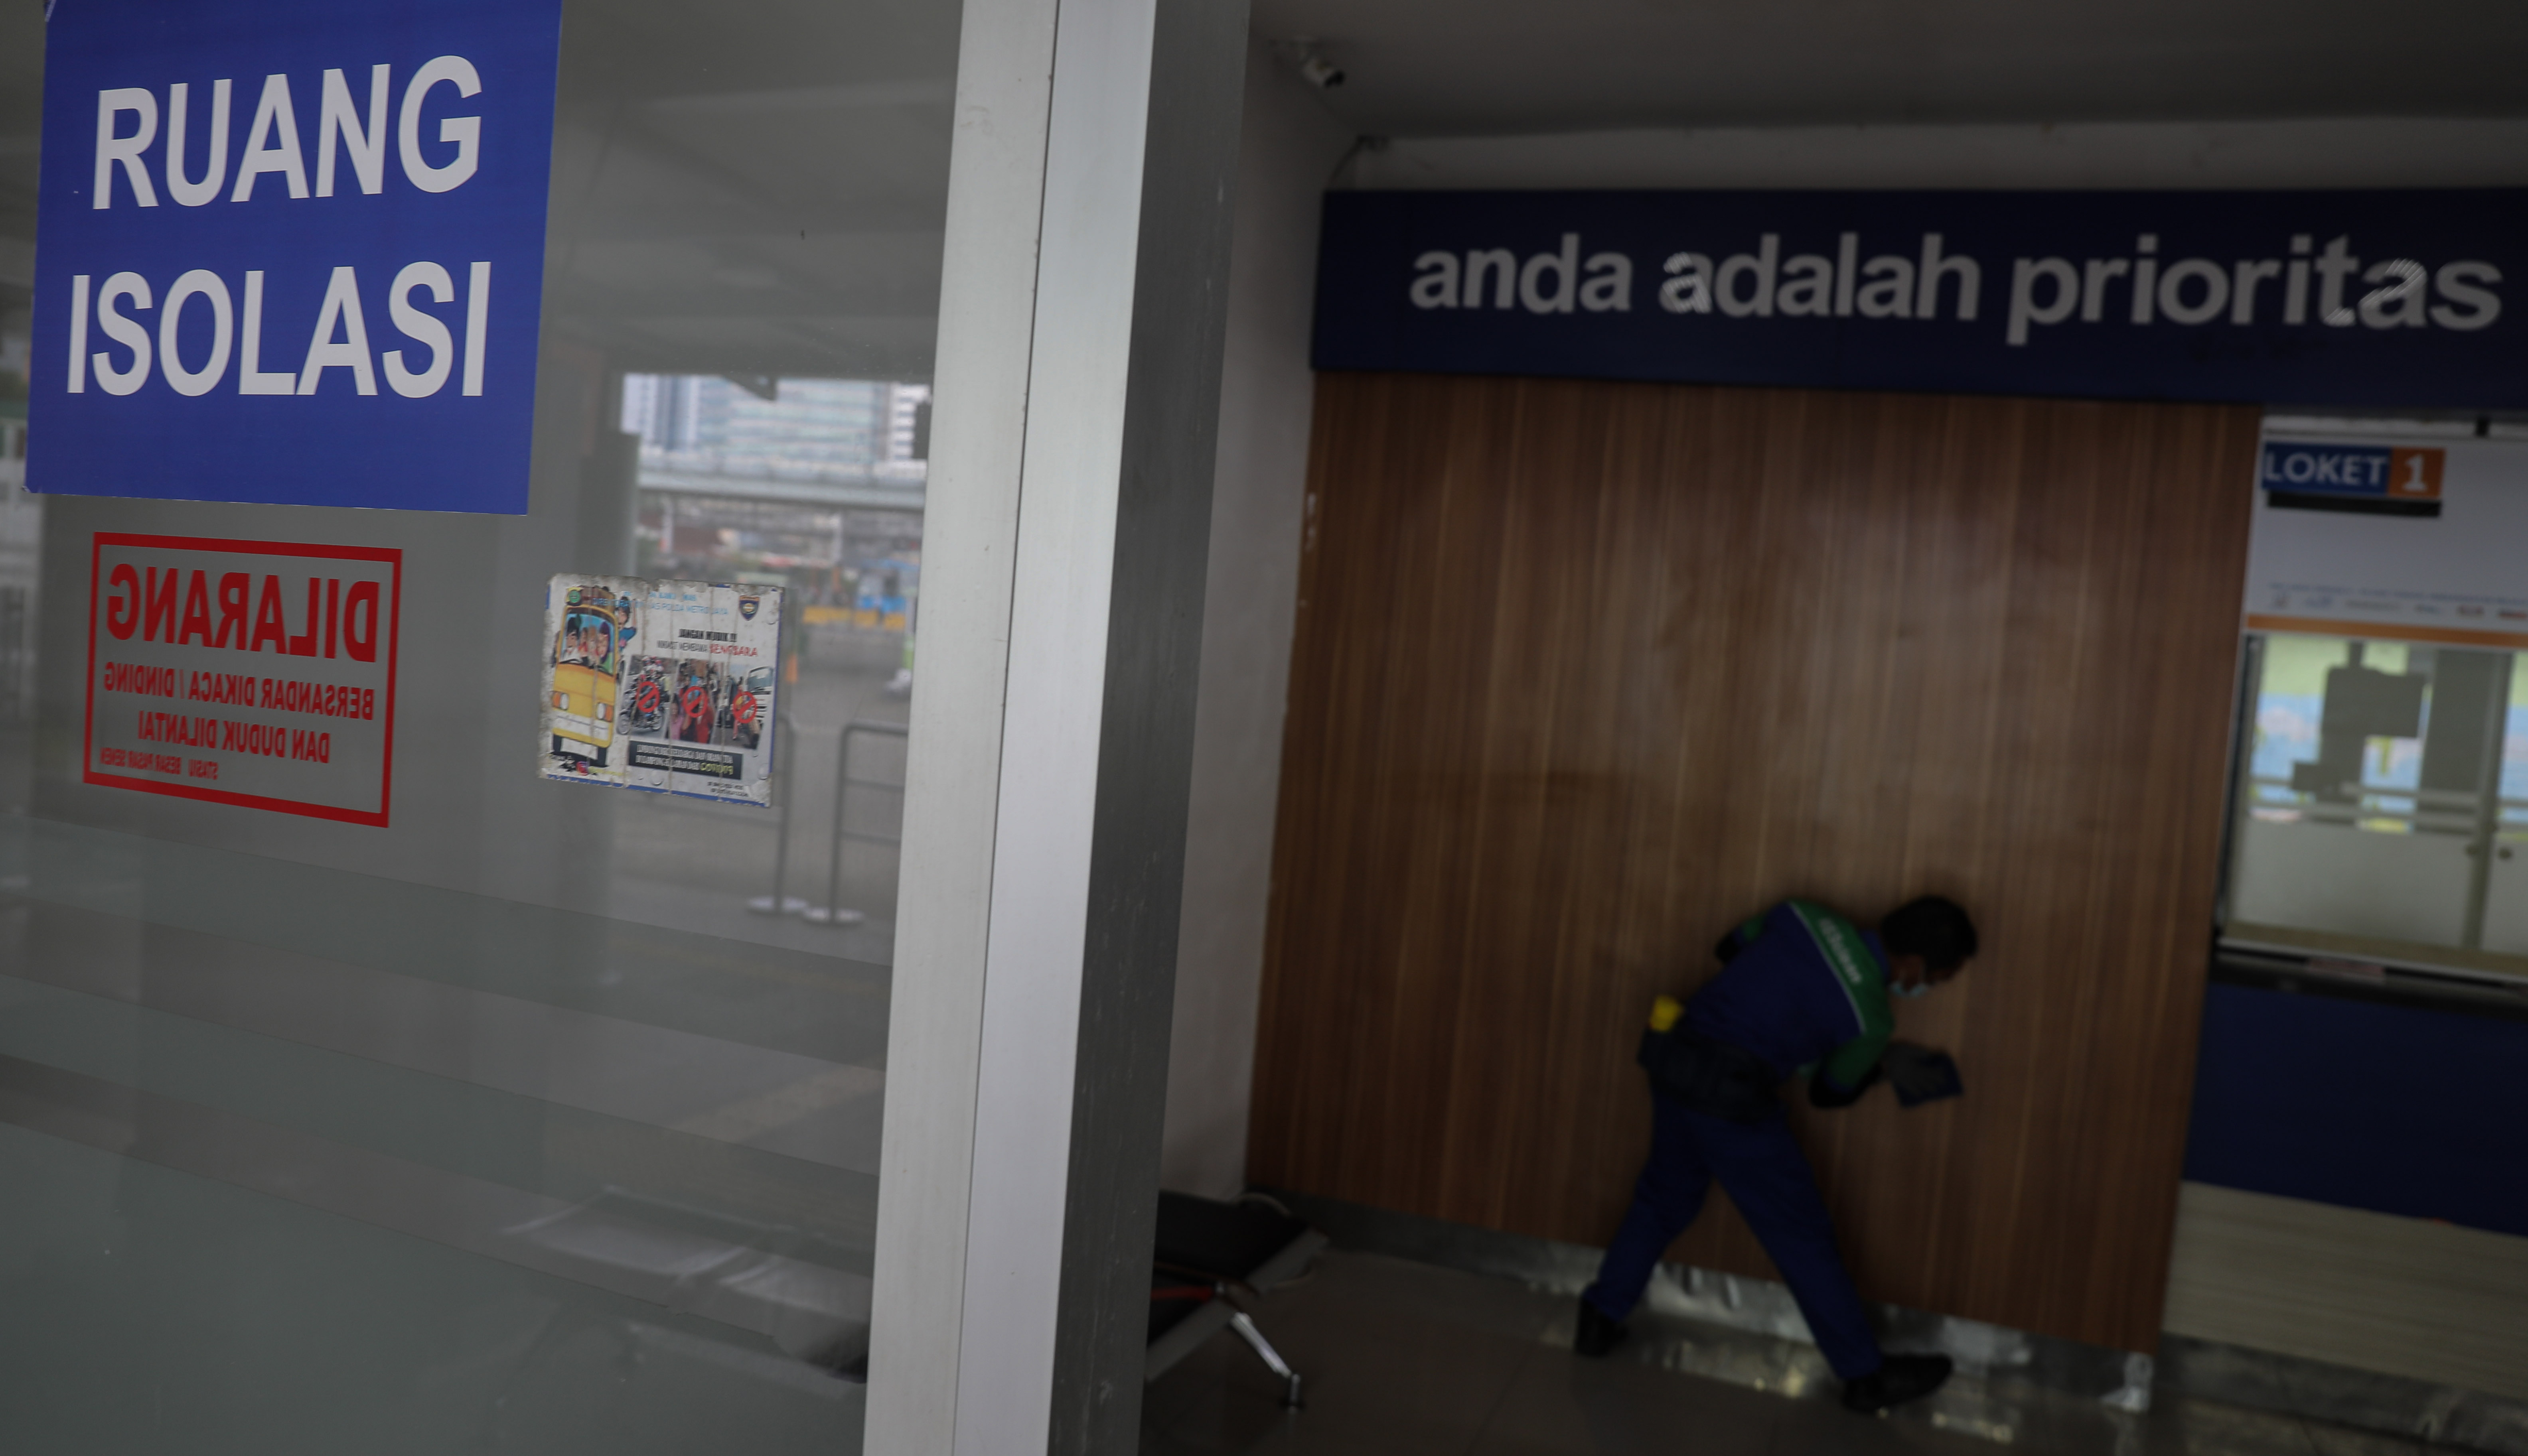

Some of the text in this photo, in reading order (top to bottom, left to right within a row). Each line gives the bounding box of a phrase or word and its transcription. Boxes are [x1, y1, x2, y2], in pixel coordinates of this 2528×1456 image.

[93, 55, 482, 209] RUANG
[67, 261, 491, 398] ISOLASI
[1410, 232, 2501, 346] anda adalah prioritas
[2265, 451, 2427, 492] LOKET 1
[709, 644, 757, 656] SENGSARA
